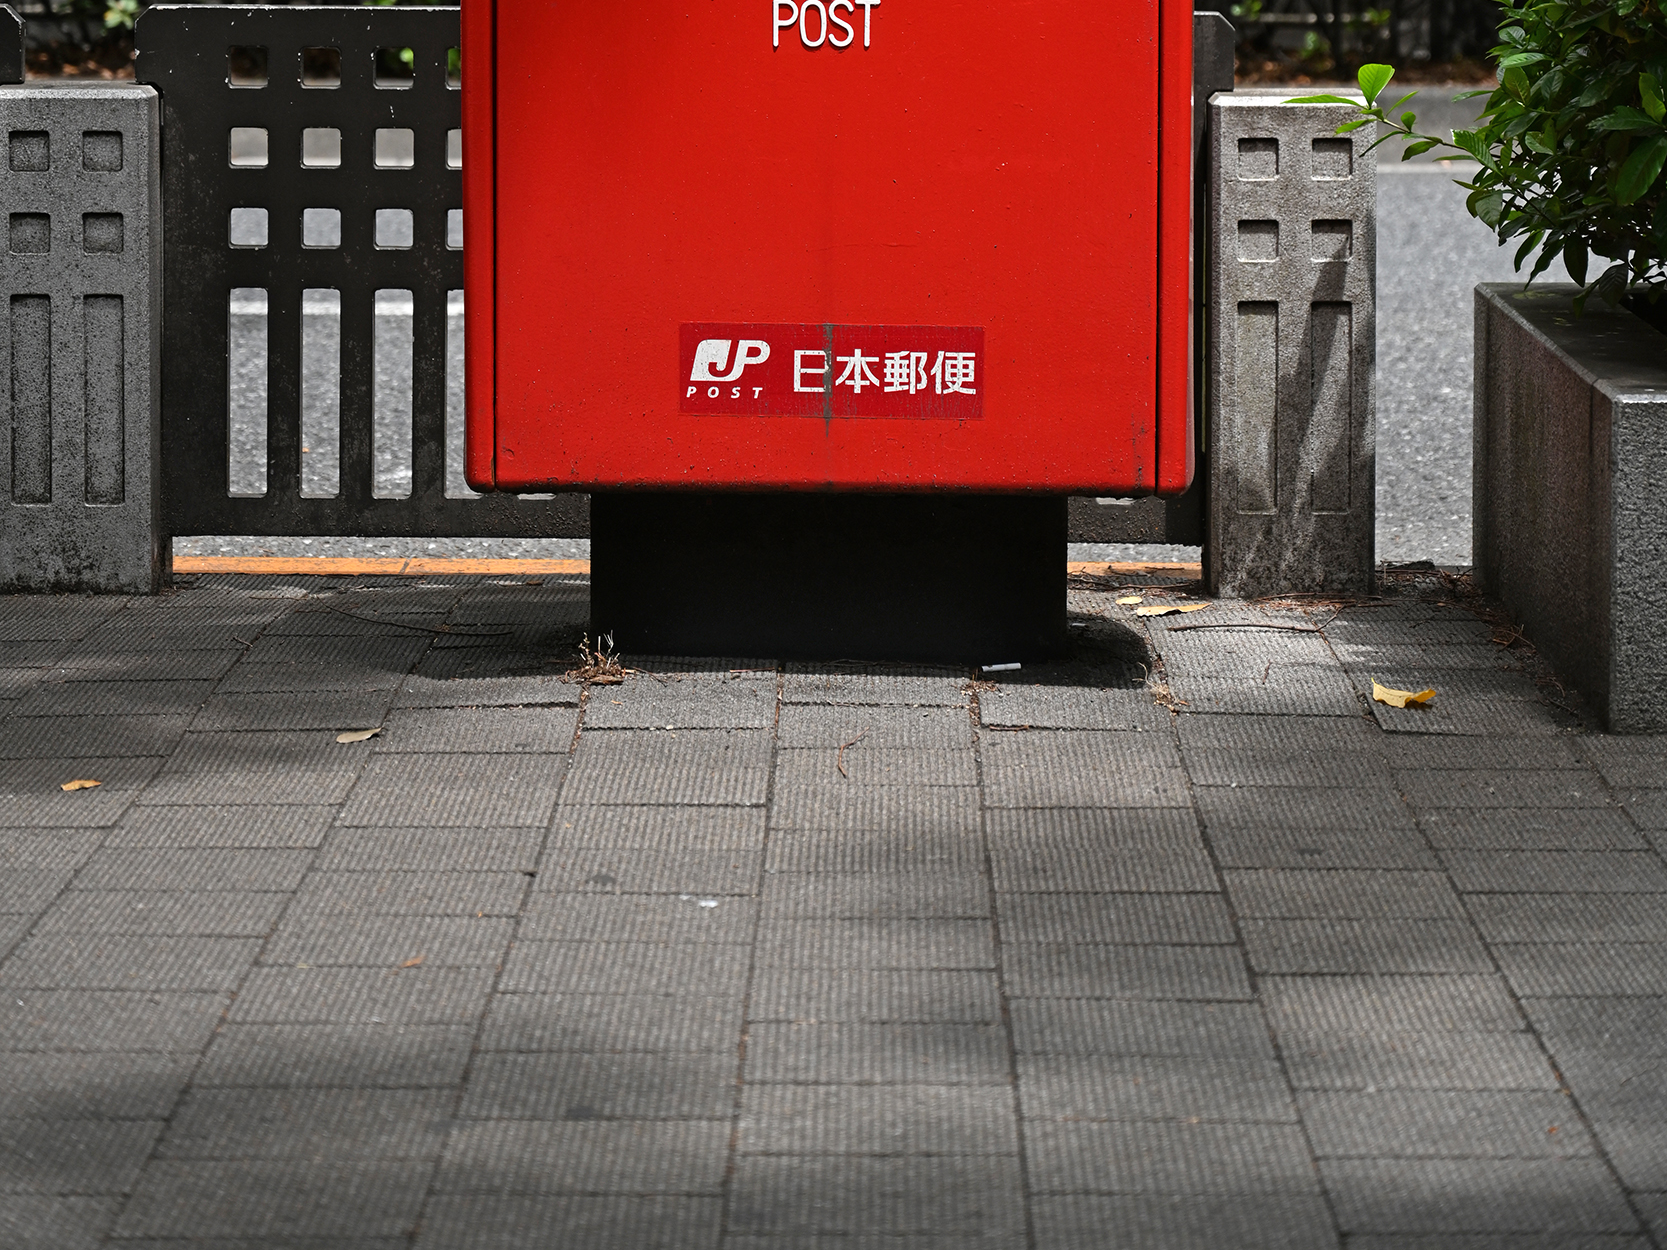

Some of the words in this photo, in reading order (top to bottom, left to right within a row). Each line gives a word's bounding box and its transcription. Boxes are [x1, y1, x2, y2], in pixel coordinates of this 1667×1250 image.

[794, 349, 977, 394] 日本郵便
[686, 386, 763, 398] POST
